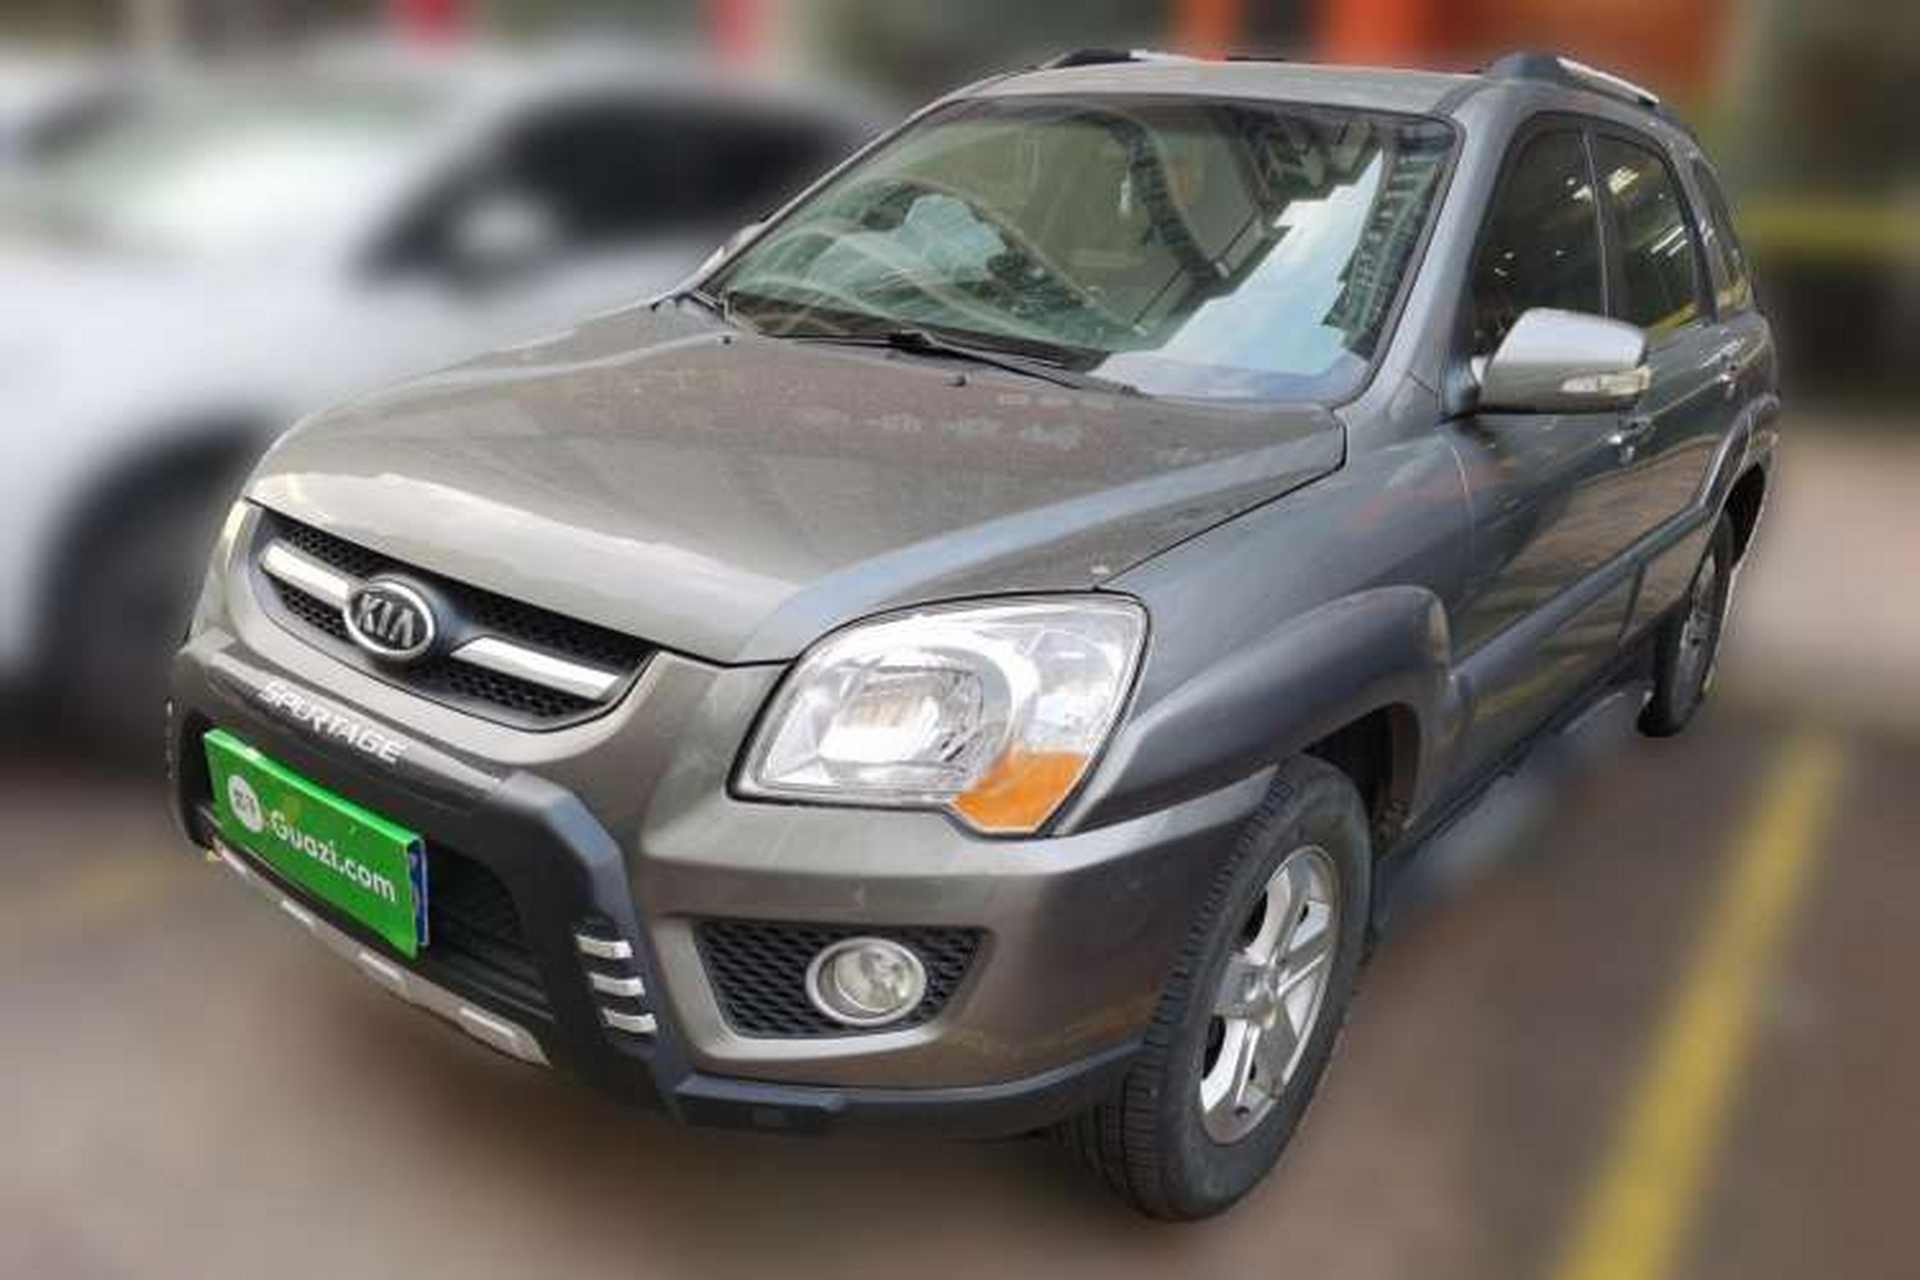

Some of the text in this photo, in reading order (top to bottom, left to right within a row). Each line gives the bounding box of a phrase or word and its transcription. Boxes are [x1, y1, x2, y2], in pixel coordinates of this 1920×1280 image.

[354, 592, 414, 648] KIA
[258, 681, 408, 764] SPORTAGE
[270, 810, 397, 902] Guazi.com
